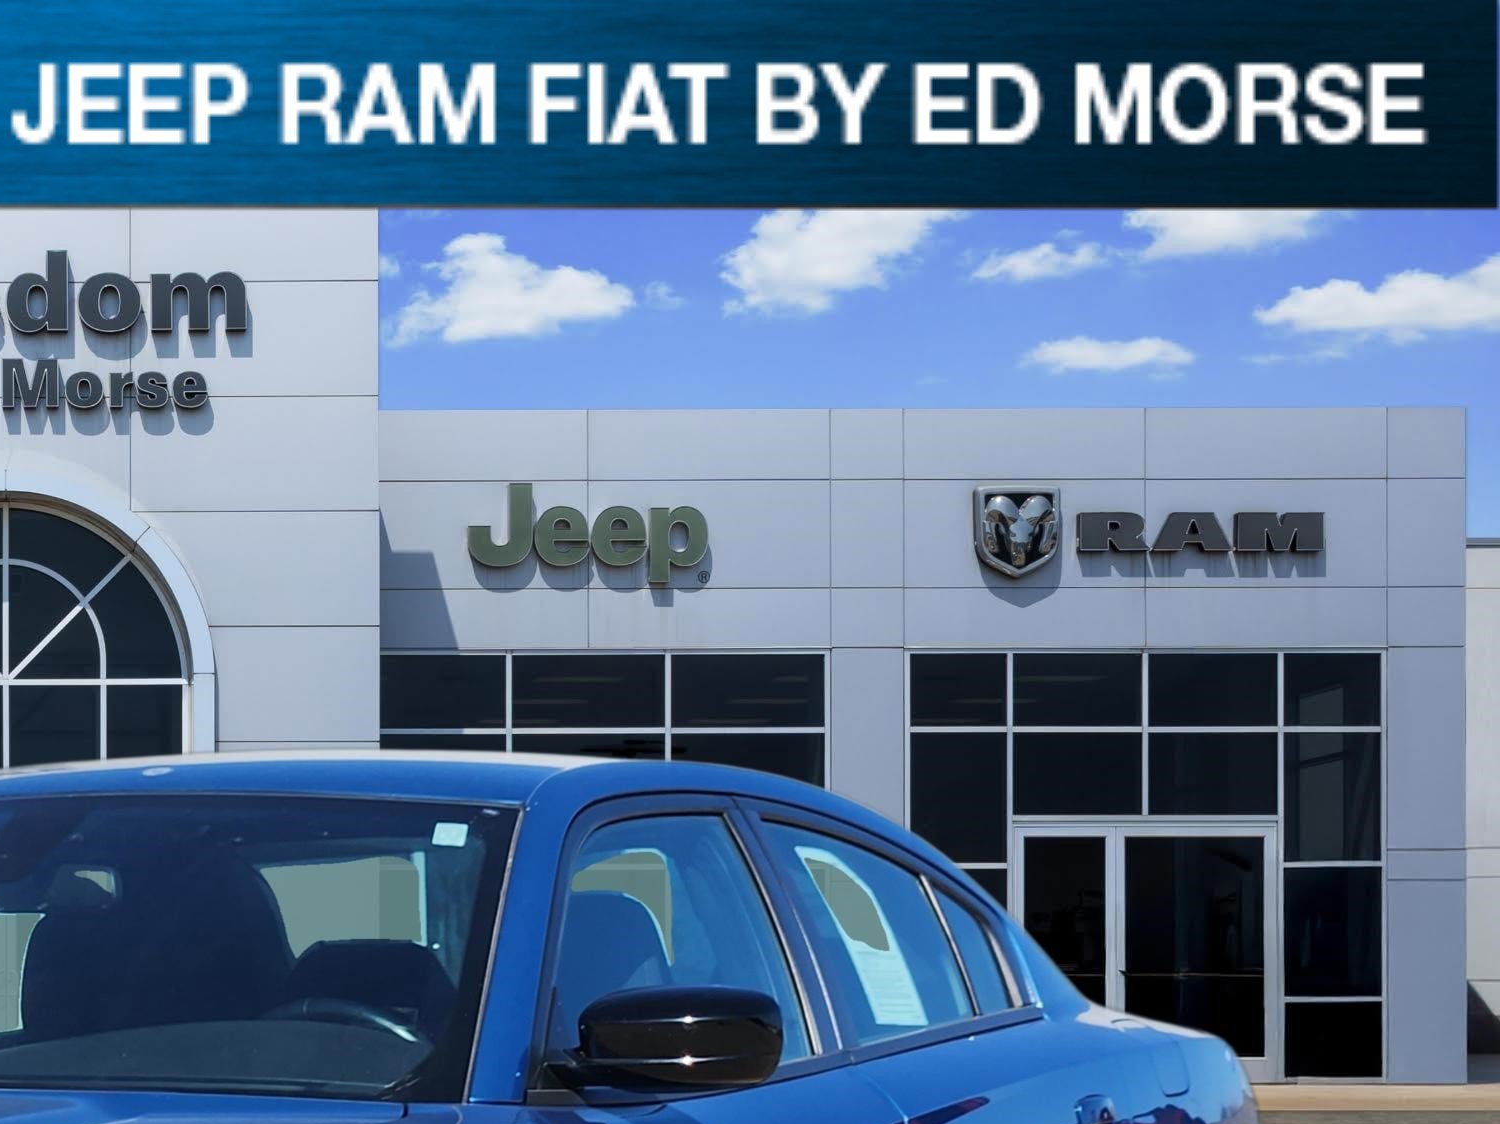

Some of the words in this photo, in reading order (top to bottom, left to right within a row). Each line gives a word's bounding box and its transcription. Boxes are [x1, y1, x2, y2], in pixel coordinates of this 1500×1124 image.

[2, 358, 210, 409] Morse
[467, 483, 709, 583] Jeep
[1076, 511, 1326, 552] RAM
